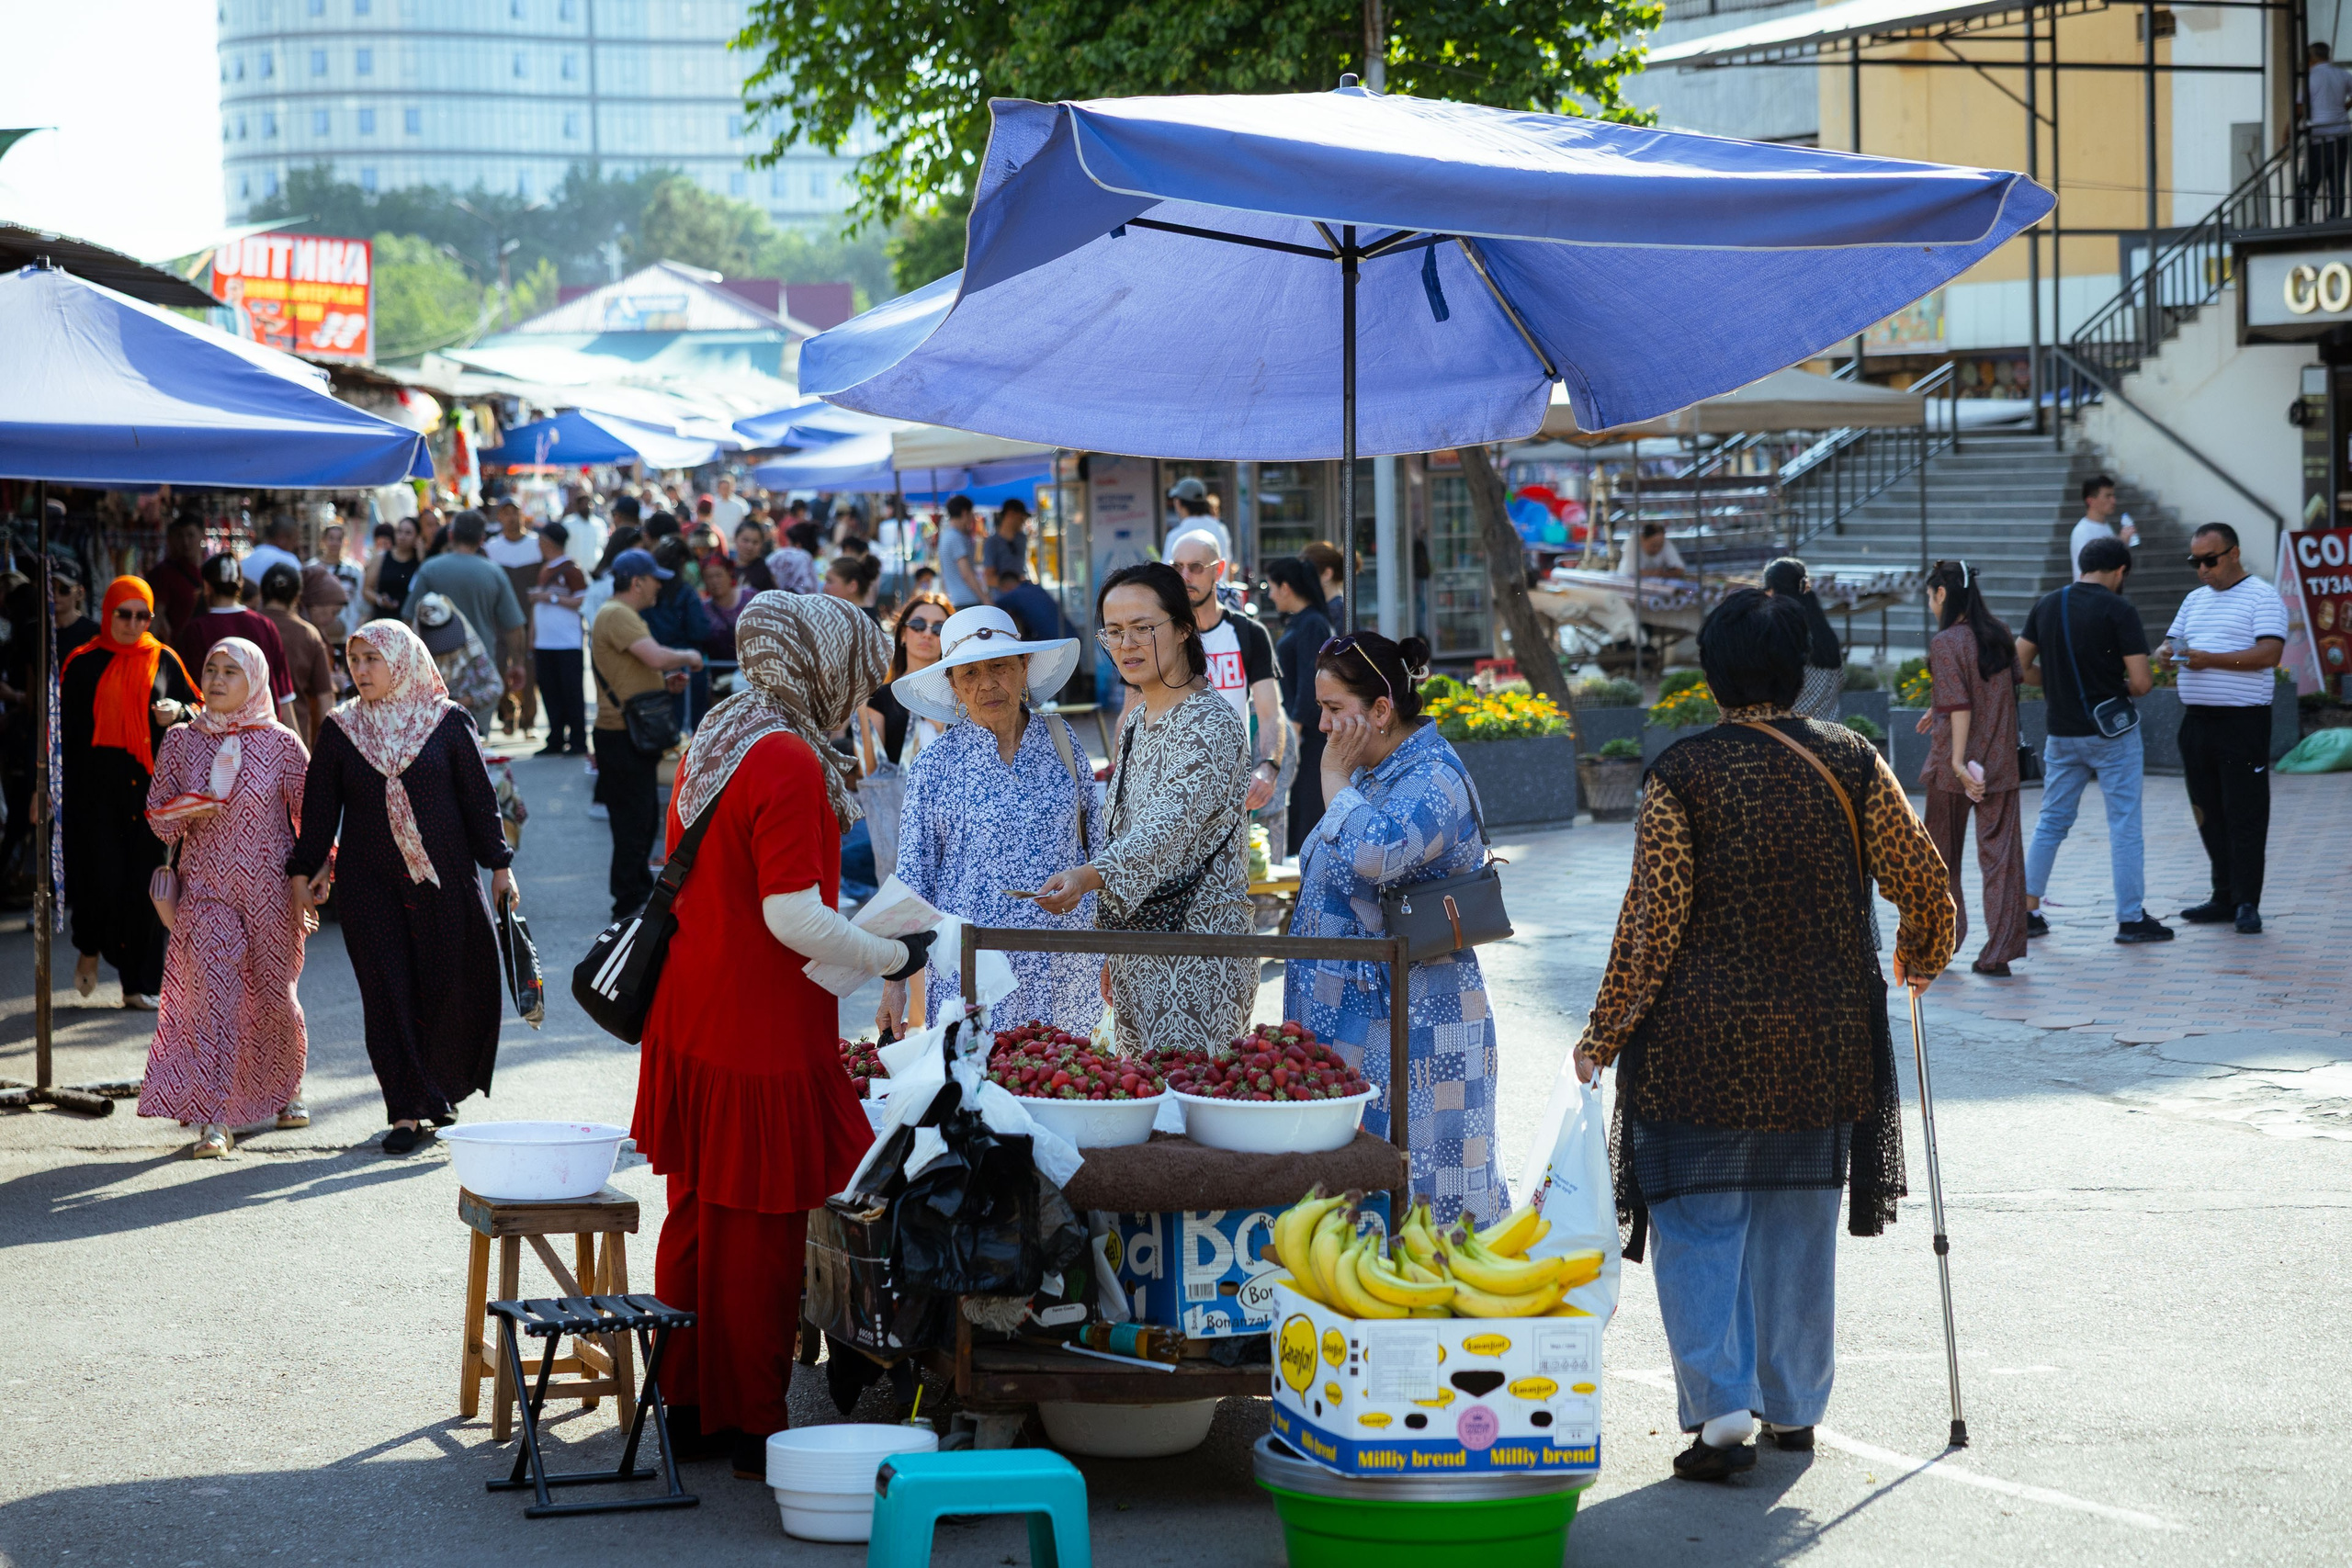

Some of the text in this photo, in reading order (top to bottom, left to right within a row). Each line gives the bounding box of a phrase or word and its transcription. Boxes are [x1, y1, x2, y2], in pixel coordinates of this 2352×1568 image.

[214, 236, 368, 285] ОПТИКА
[1206, 1314, 1269, 1330] Bonanza!
[1314, 1437, 1338, 1462] brend
[1358, 1449, 1466, 1471] Milliy brend
[1490, 1446, 1596, 1468] Milliy brend
